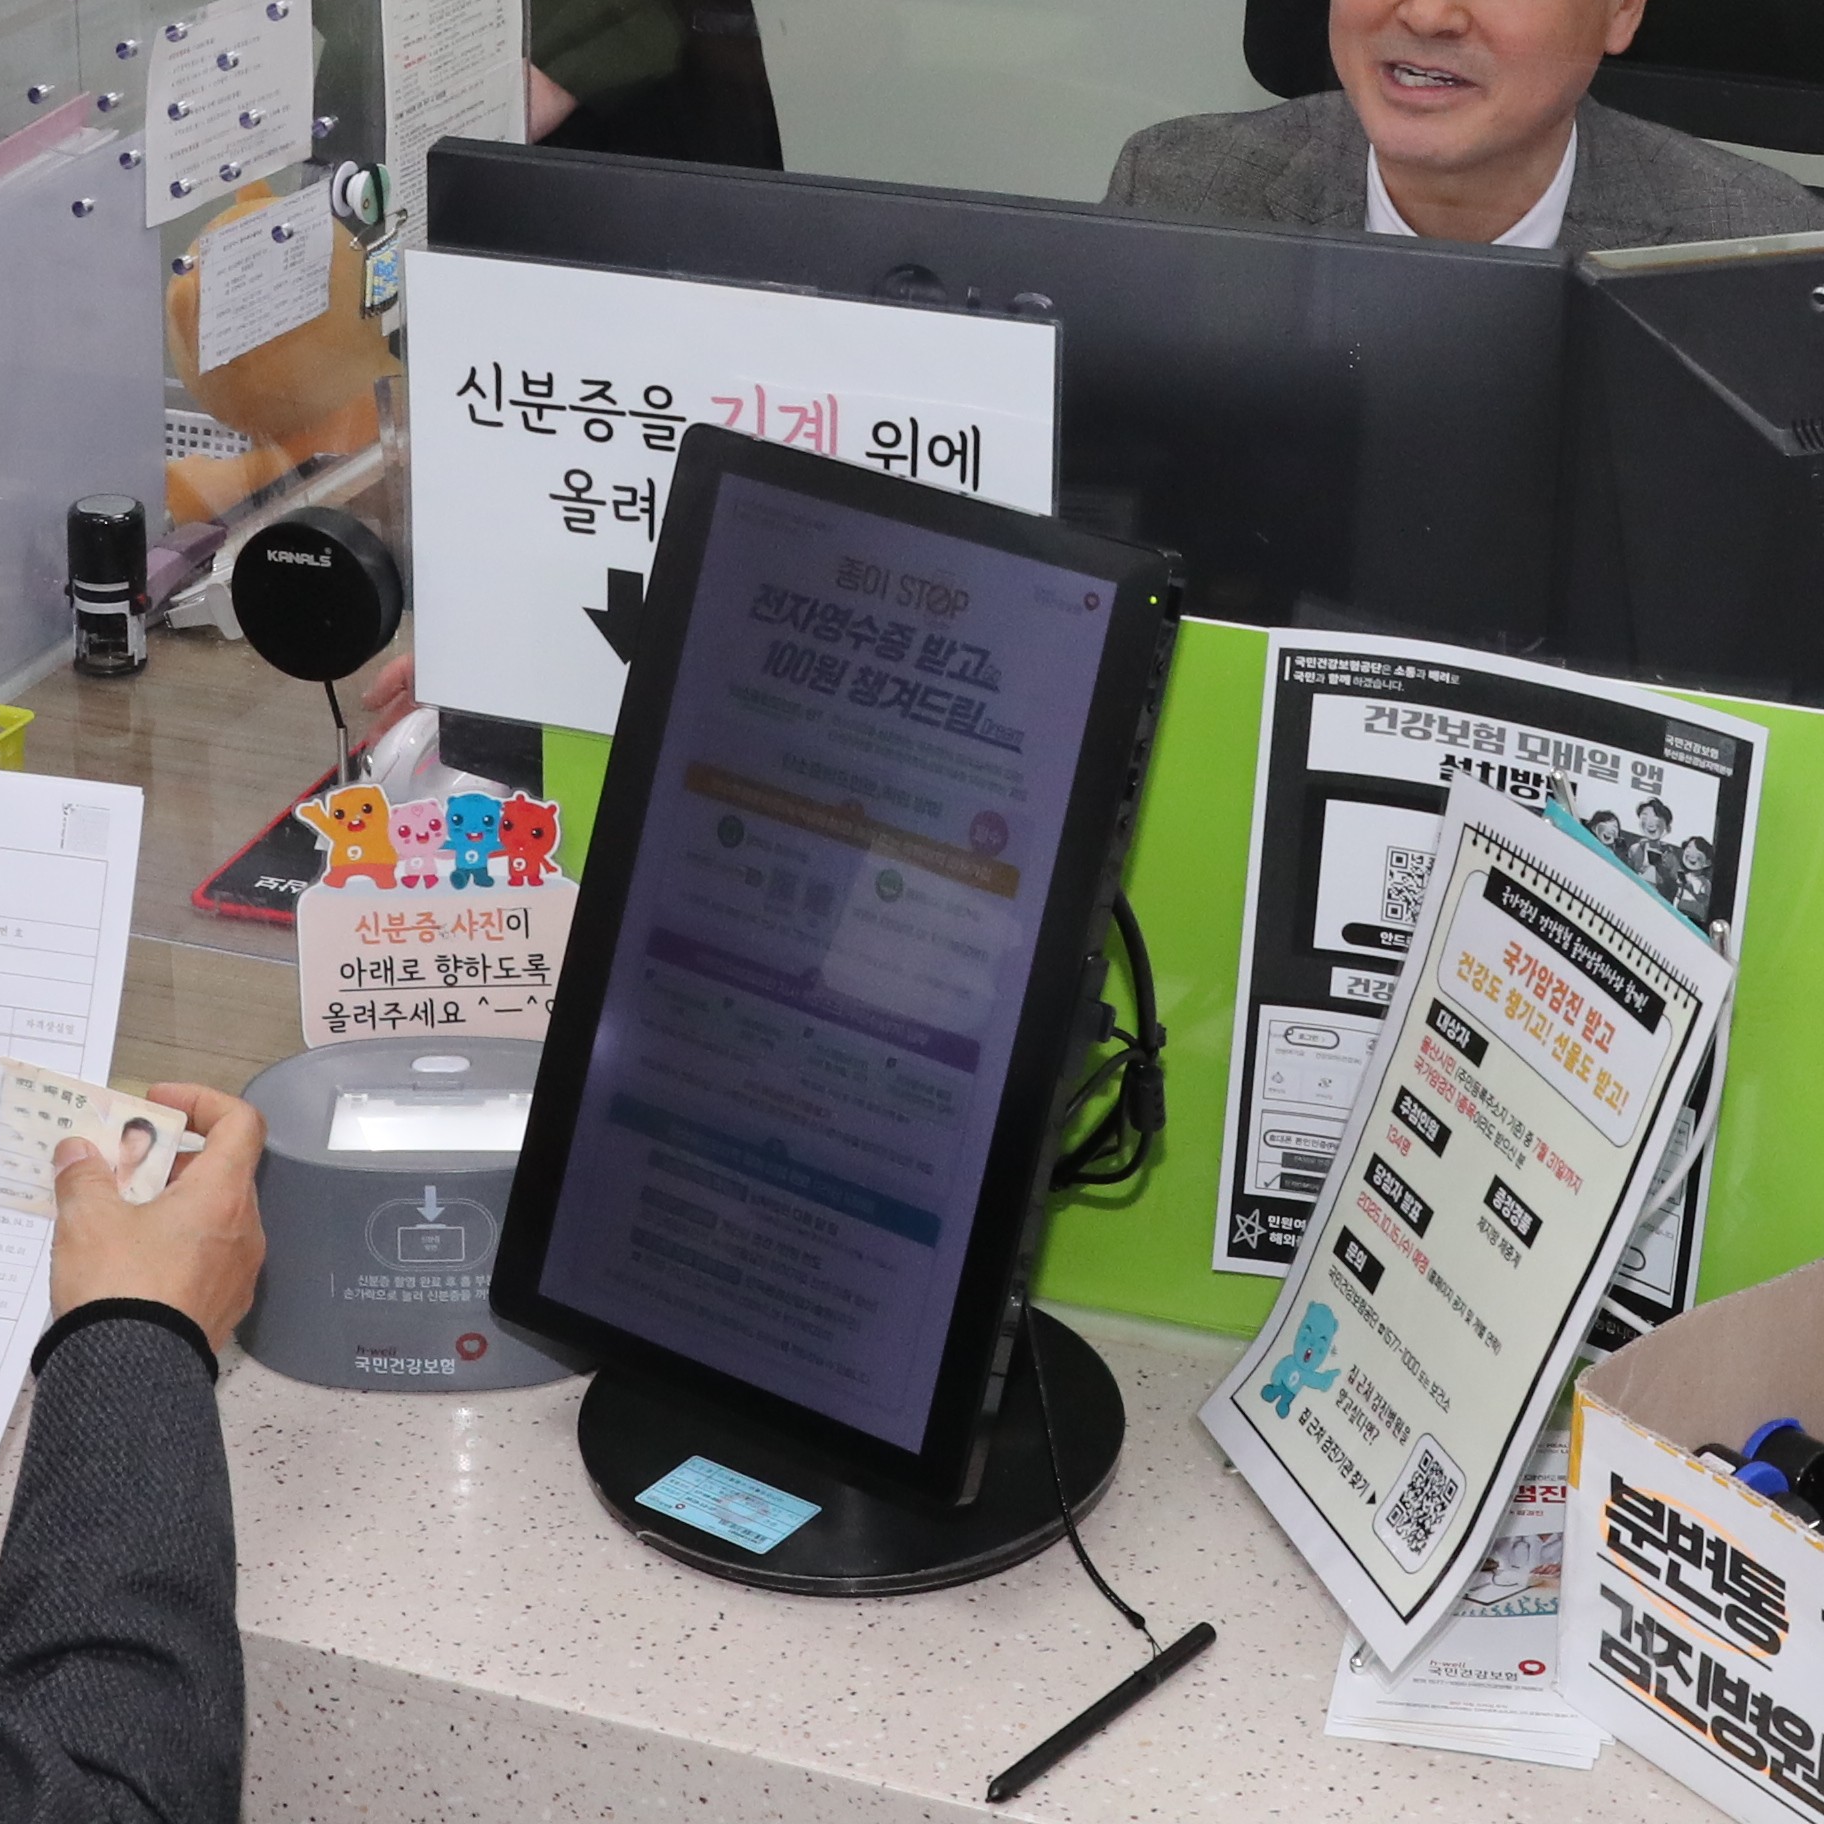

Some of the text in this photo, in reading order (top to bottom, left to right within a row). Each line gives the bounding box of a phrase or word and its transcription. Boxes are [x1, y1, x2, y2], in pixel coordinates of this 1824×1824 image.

[456, 361, 983, 492] 신분증을 기계 위에
[550, 468, 660, 542] 올려
[1365, 706, 1663, 795] 건강보험 모바일 앱
[356, 908, 529, 944] 신분증 사진이
[339, 953, 551, 988] 아래로 향하도록
[1503, 944, 1615, 1053] 국가암검진 받고
[323, 999, 465, 1033] 올려주세요
[1433, 1010, 1470, 1048] 대상자
[1459, 955, 1501, 1002] 건강도
[1593, 1068, 1629, 1113] 받고!
[356, 1357, 455, 1375] 국민건강보험
[1605, 1471, 1790, 1657] 분변통
